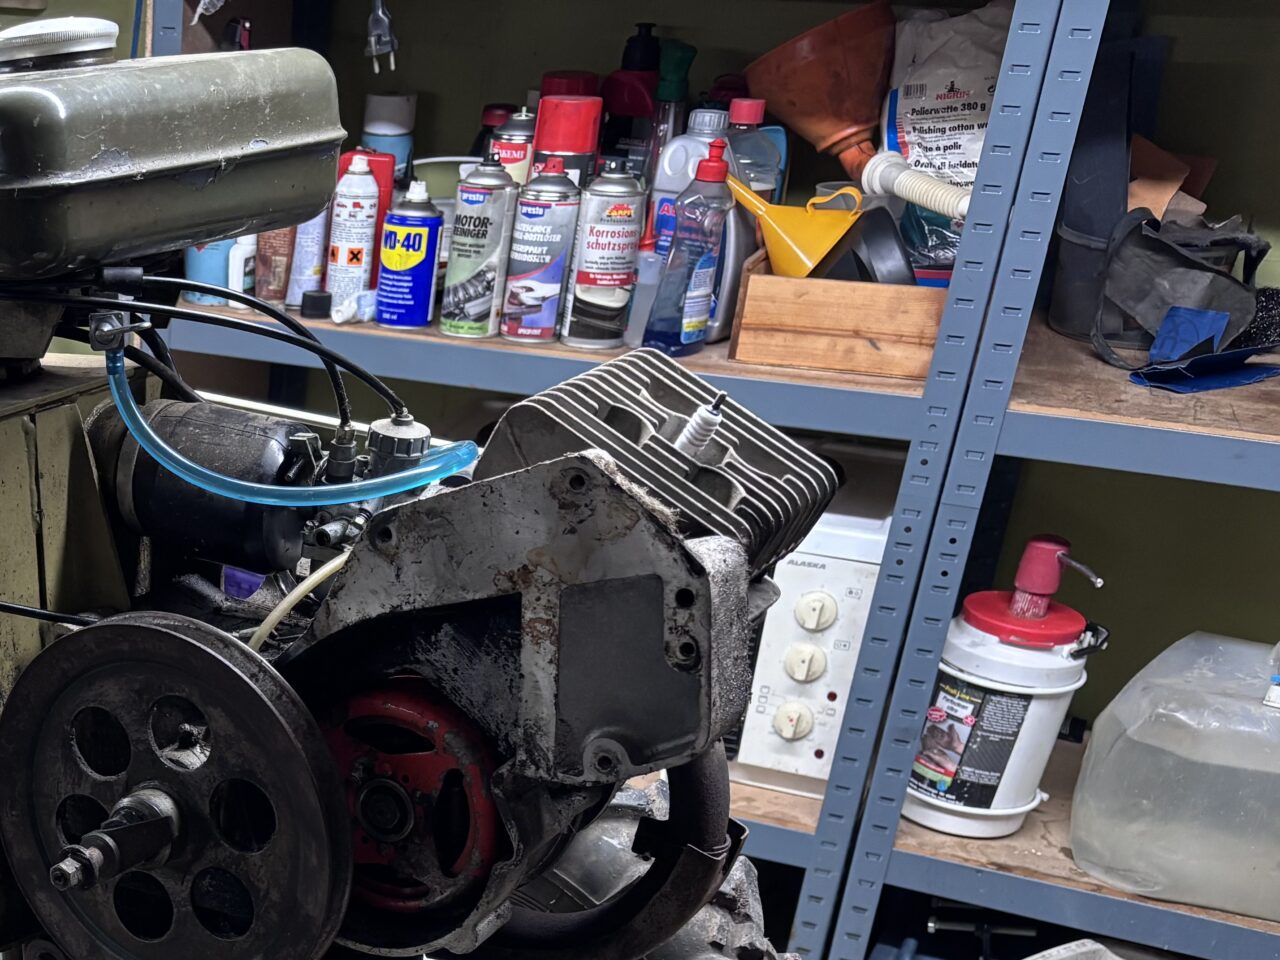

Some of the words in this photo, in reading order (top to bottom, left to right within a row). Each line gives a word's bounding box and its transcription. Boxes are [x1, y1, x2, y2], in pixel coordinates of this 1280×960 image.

[960, 101, 978, 112] 380
[980, 102, 986, 112] g
[948, 122, 975, 133] cotton
[943, 141, 962, 153] polir
[786, 558, 827, 570] ALASKA
